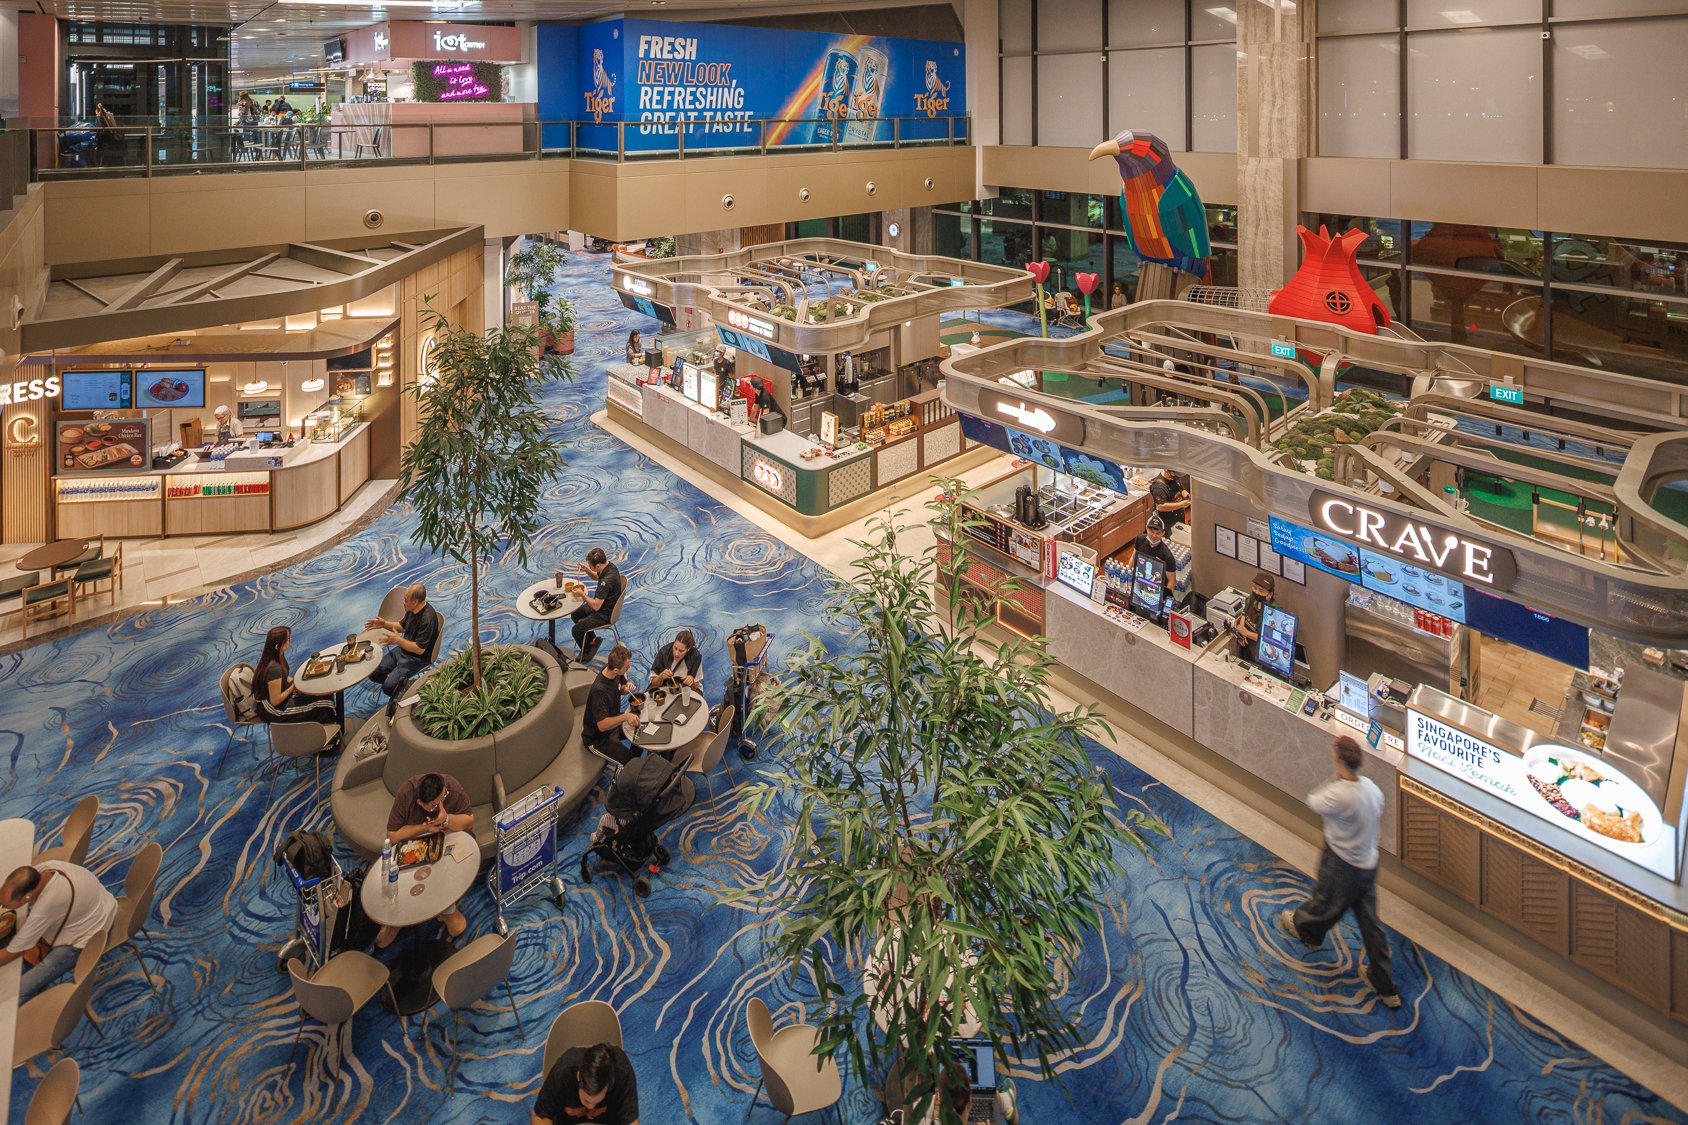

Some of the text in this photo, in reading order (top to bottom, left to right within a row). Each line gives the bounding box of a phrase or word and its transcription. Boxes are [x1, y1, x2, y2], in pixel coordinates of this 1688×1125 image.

[638, 35, 698, 60] FRESH
[434, 65, 447, 74] All
[453, 64, 471, 73] need
[637, 60, 683, 85] NEW
[584, 89, 616, 123] Tiger
[639, 86, 745, 110] REFRESHING
[818, 91, 848, 120] Tige
[914, 92, 950, 119] Tiger
[639, 111, 754, 135] GREAT TASTE
[1275, 346, 1291, 357] EXIT
[1495, 388, 1517, 401] EXIT
[1321, 500, 1493, 584] CRAVE
[1417, 717, 1501, 764] SINGAPORE'S
[1418, 731, 1484, 769] FAVOURITE
[1417, 740, 1518, 797] Nasi Lemak
[511, 861, 543, 884] Trip.com
